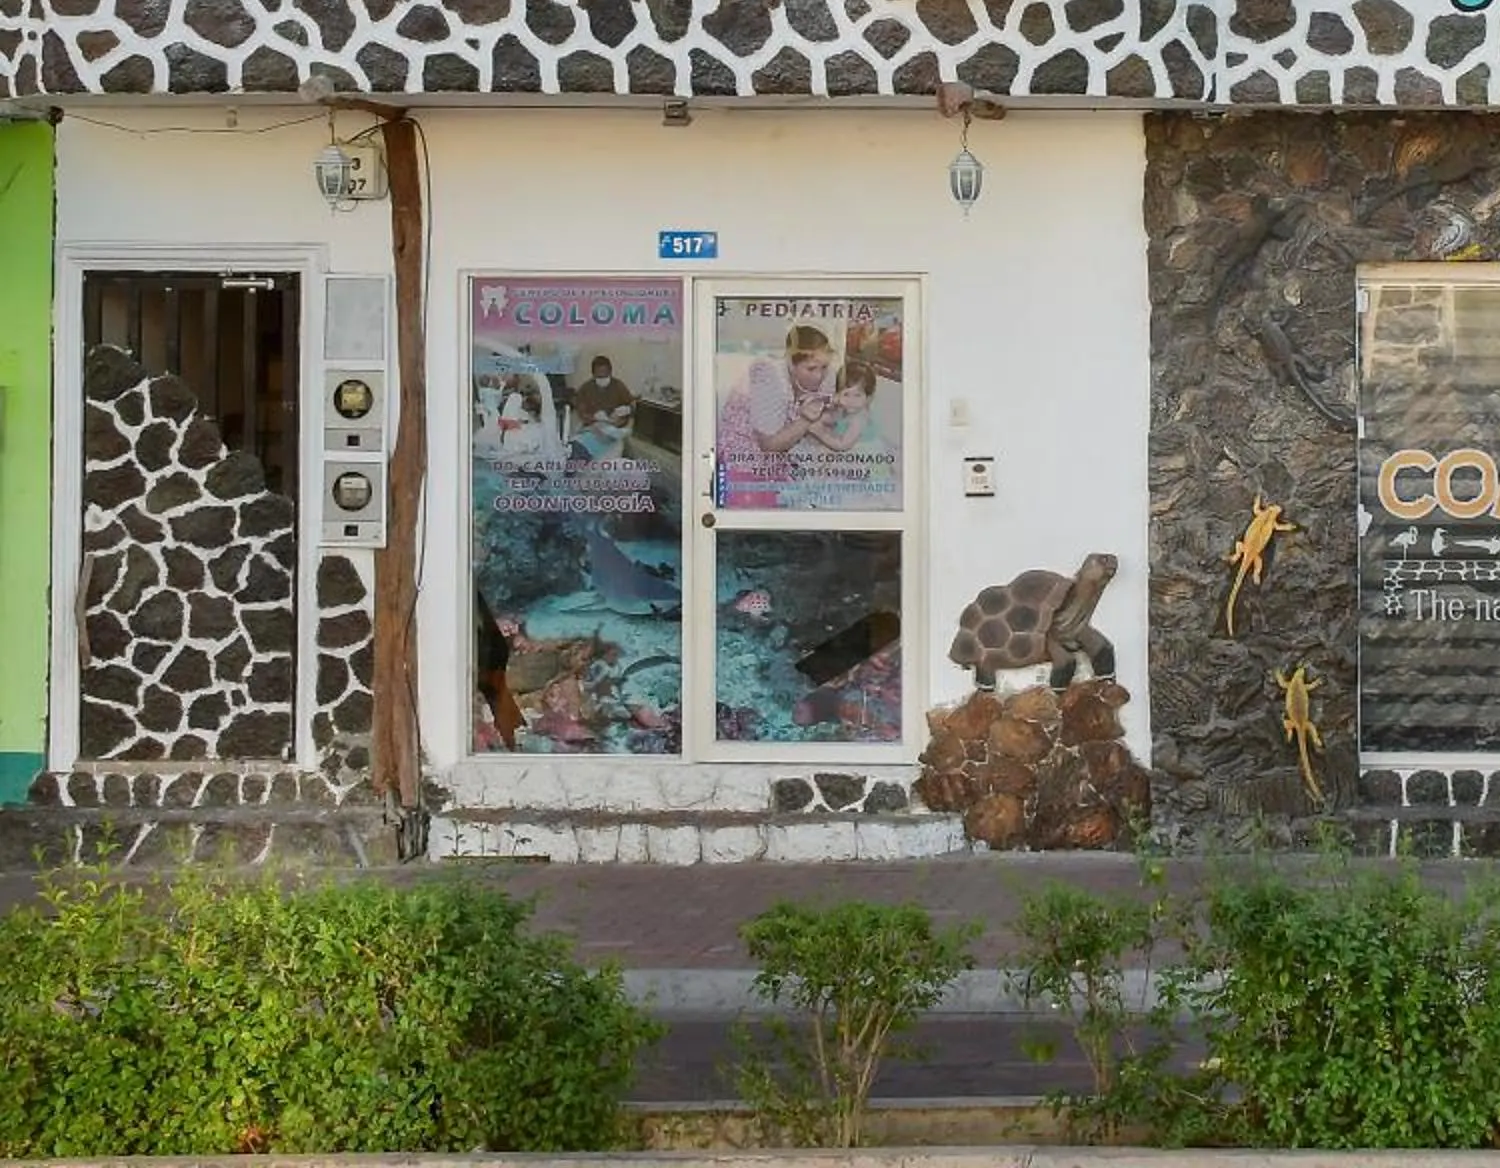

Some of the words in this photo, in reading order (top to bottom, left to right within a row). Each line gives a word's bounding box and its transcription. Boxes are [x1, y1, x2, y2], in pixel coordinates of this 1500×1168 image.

[672, 237, 704, 253] 517
[513, 302, 676, 326] COLOMA
[817, 453, 896, 465] CORONADO
[494, 492, 656, 513] ODONTOLOGÍA
[1409, 589, 1466, 621] The
